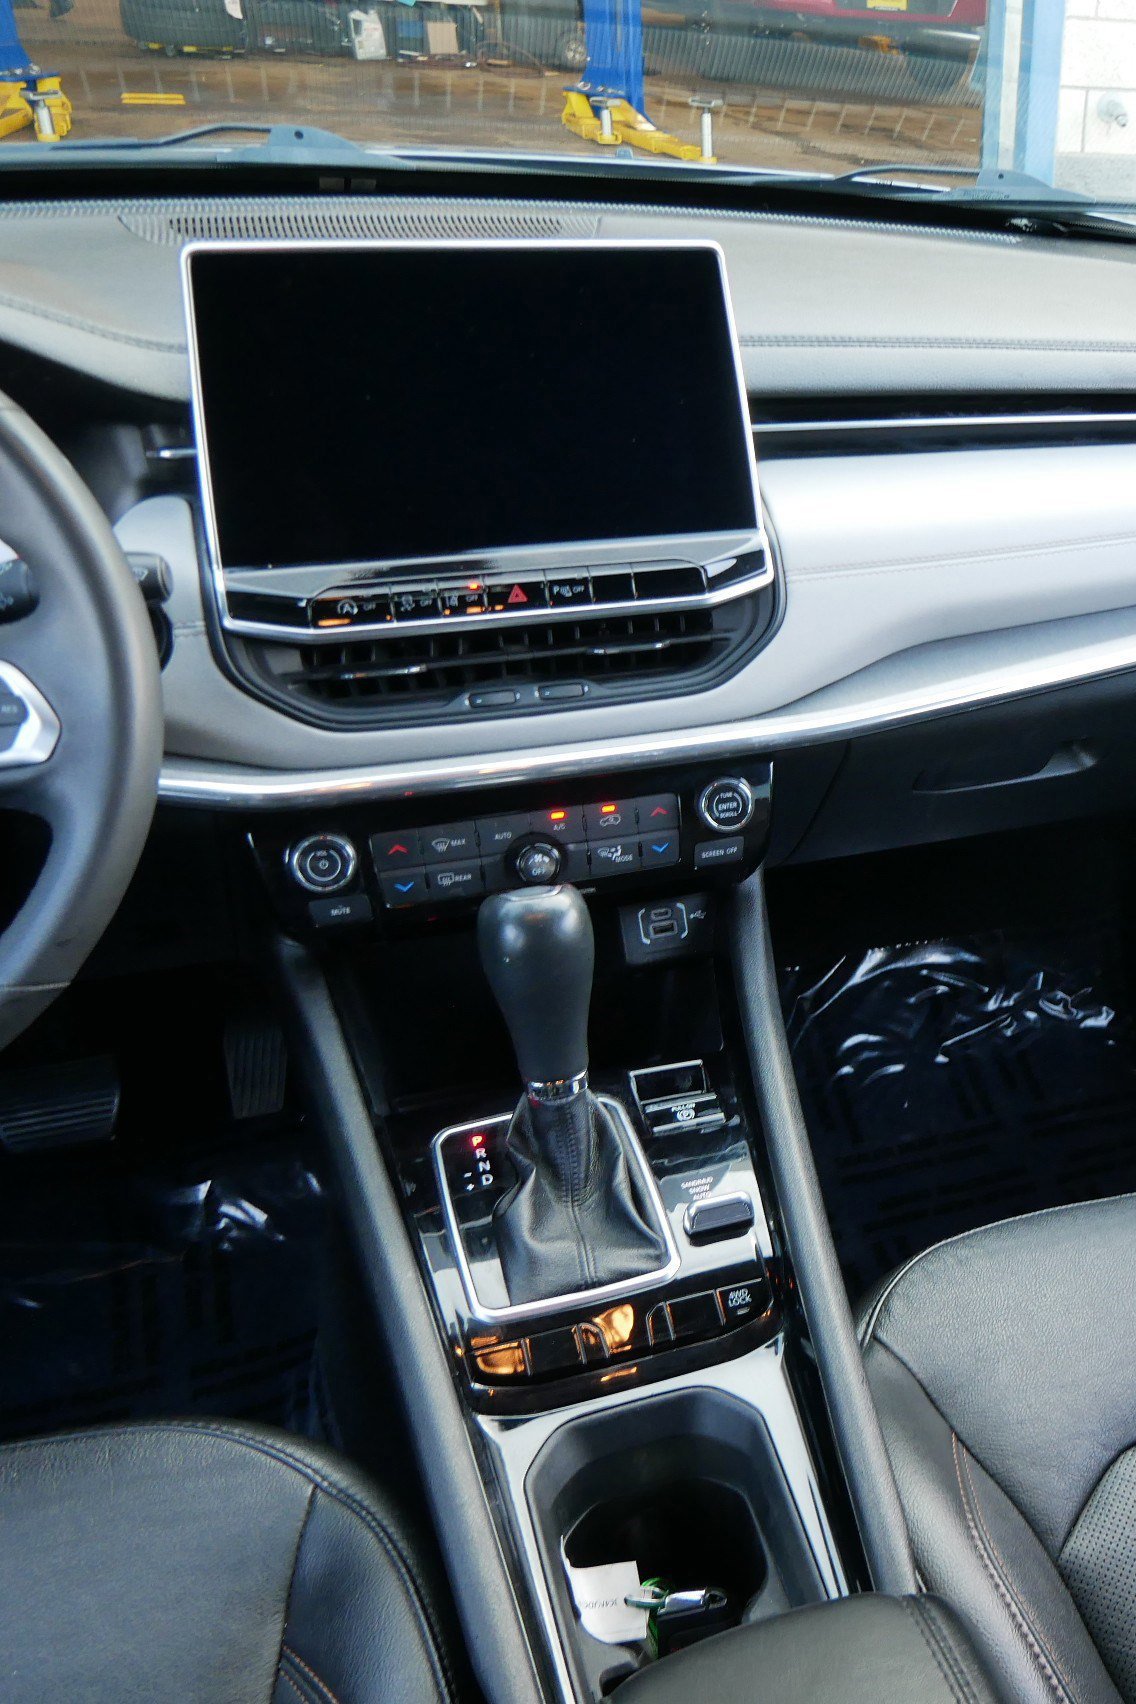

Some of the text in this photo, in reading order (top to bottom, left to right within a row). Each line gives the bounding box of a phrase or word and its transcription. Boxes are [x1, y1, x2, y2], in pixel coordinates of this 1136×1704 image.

[720, 791, 733, 799] TUNE
[719, 801, 738, 811] ENTER
[553, 822, 566, 831] A/C
[494, 831, 512, 840] AUTO
[450, 838, 466, 847] MAX
[701, 846, 738, 859] SCREEN OFF
[615, 853, 633, 863] MODE
[532, 865, 546, 876] OFF
[454, 873, 472, 881] REAR
[331, 906, 351, 917] MUTE
[471, 1135, 483, 1147] P
[475, 1147, 487, 1159] R
[478, 1159, 491, 1172] N
[481, 1173, 494, 1186] D
[689, 1184, 710, 1194] SNOW
[728, 1294, 752, 1307] LOCK
